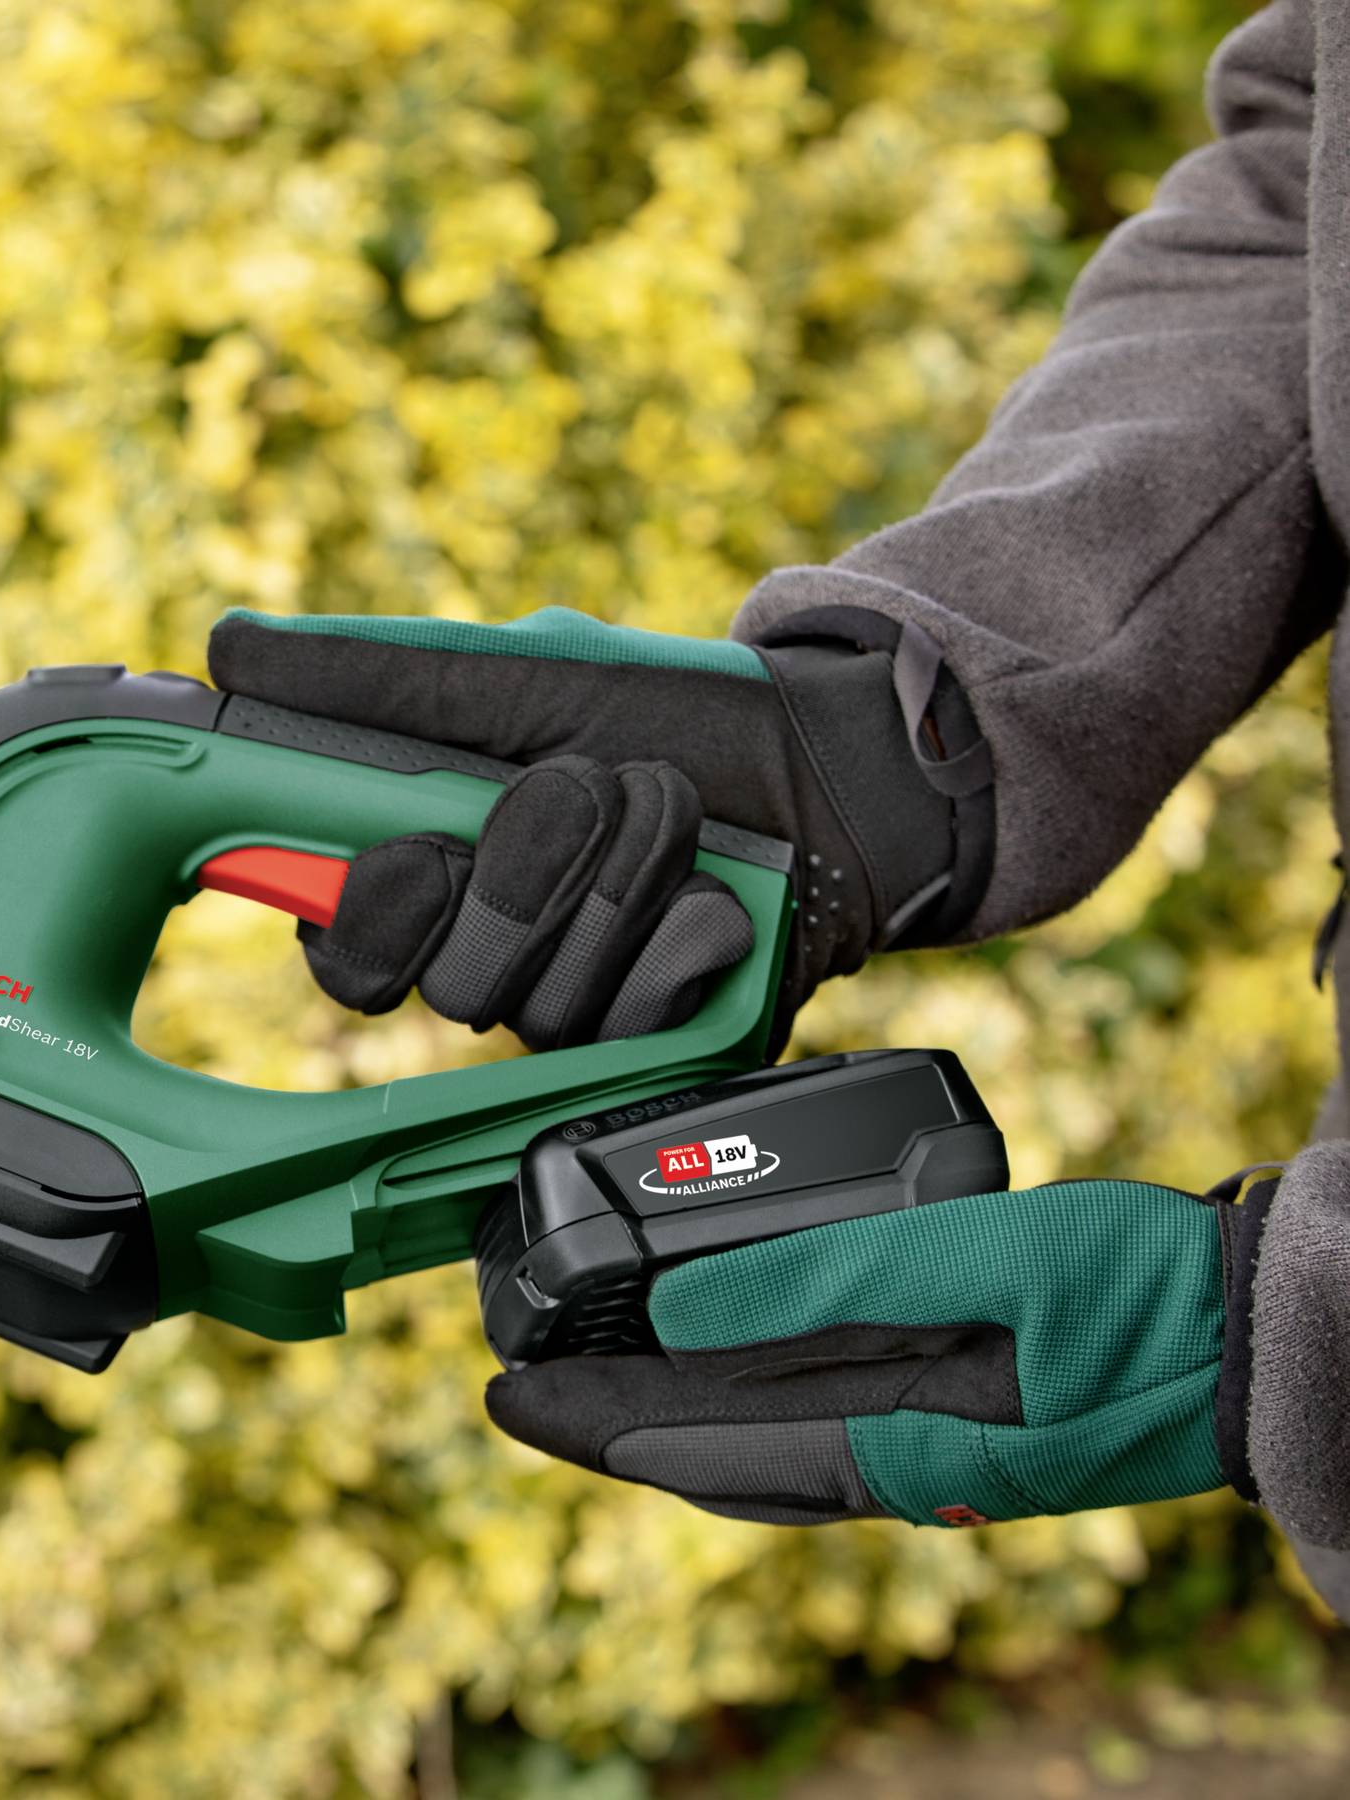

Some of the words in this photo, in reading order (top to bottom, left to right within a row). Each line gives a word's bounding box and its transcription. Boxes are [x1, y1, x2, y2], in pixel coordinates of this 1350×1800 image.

[63, 1039, 99, 1061] 18V
[607, 1092, 700, 1127] BOSCH
[663, 1148, 683, 1156] POWER
[668, 1153, 704, 1172] ALL
[715, 1145, 746, 1163] 18V
[683, 1175, 746, 1196] ALLIANCE
